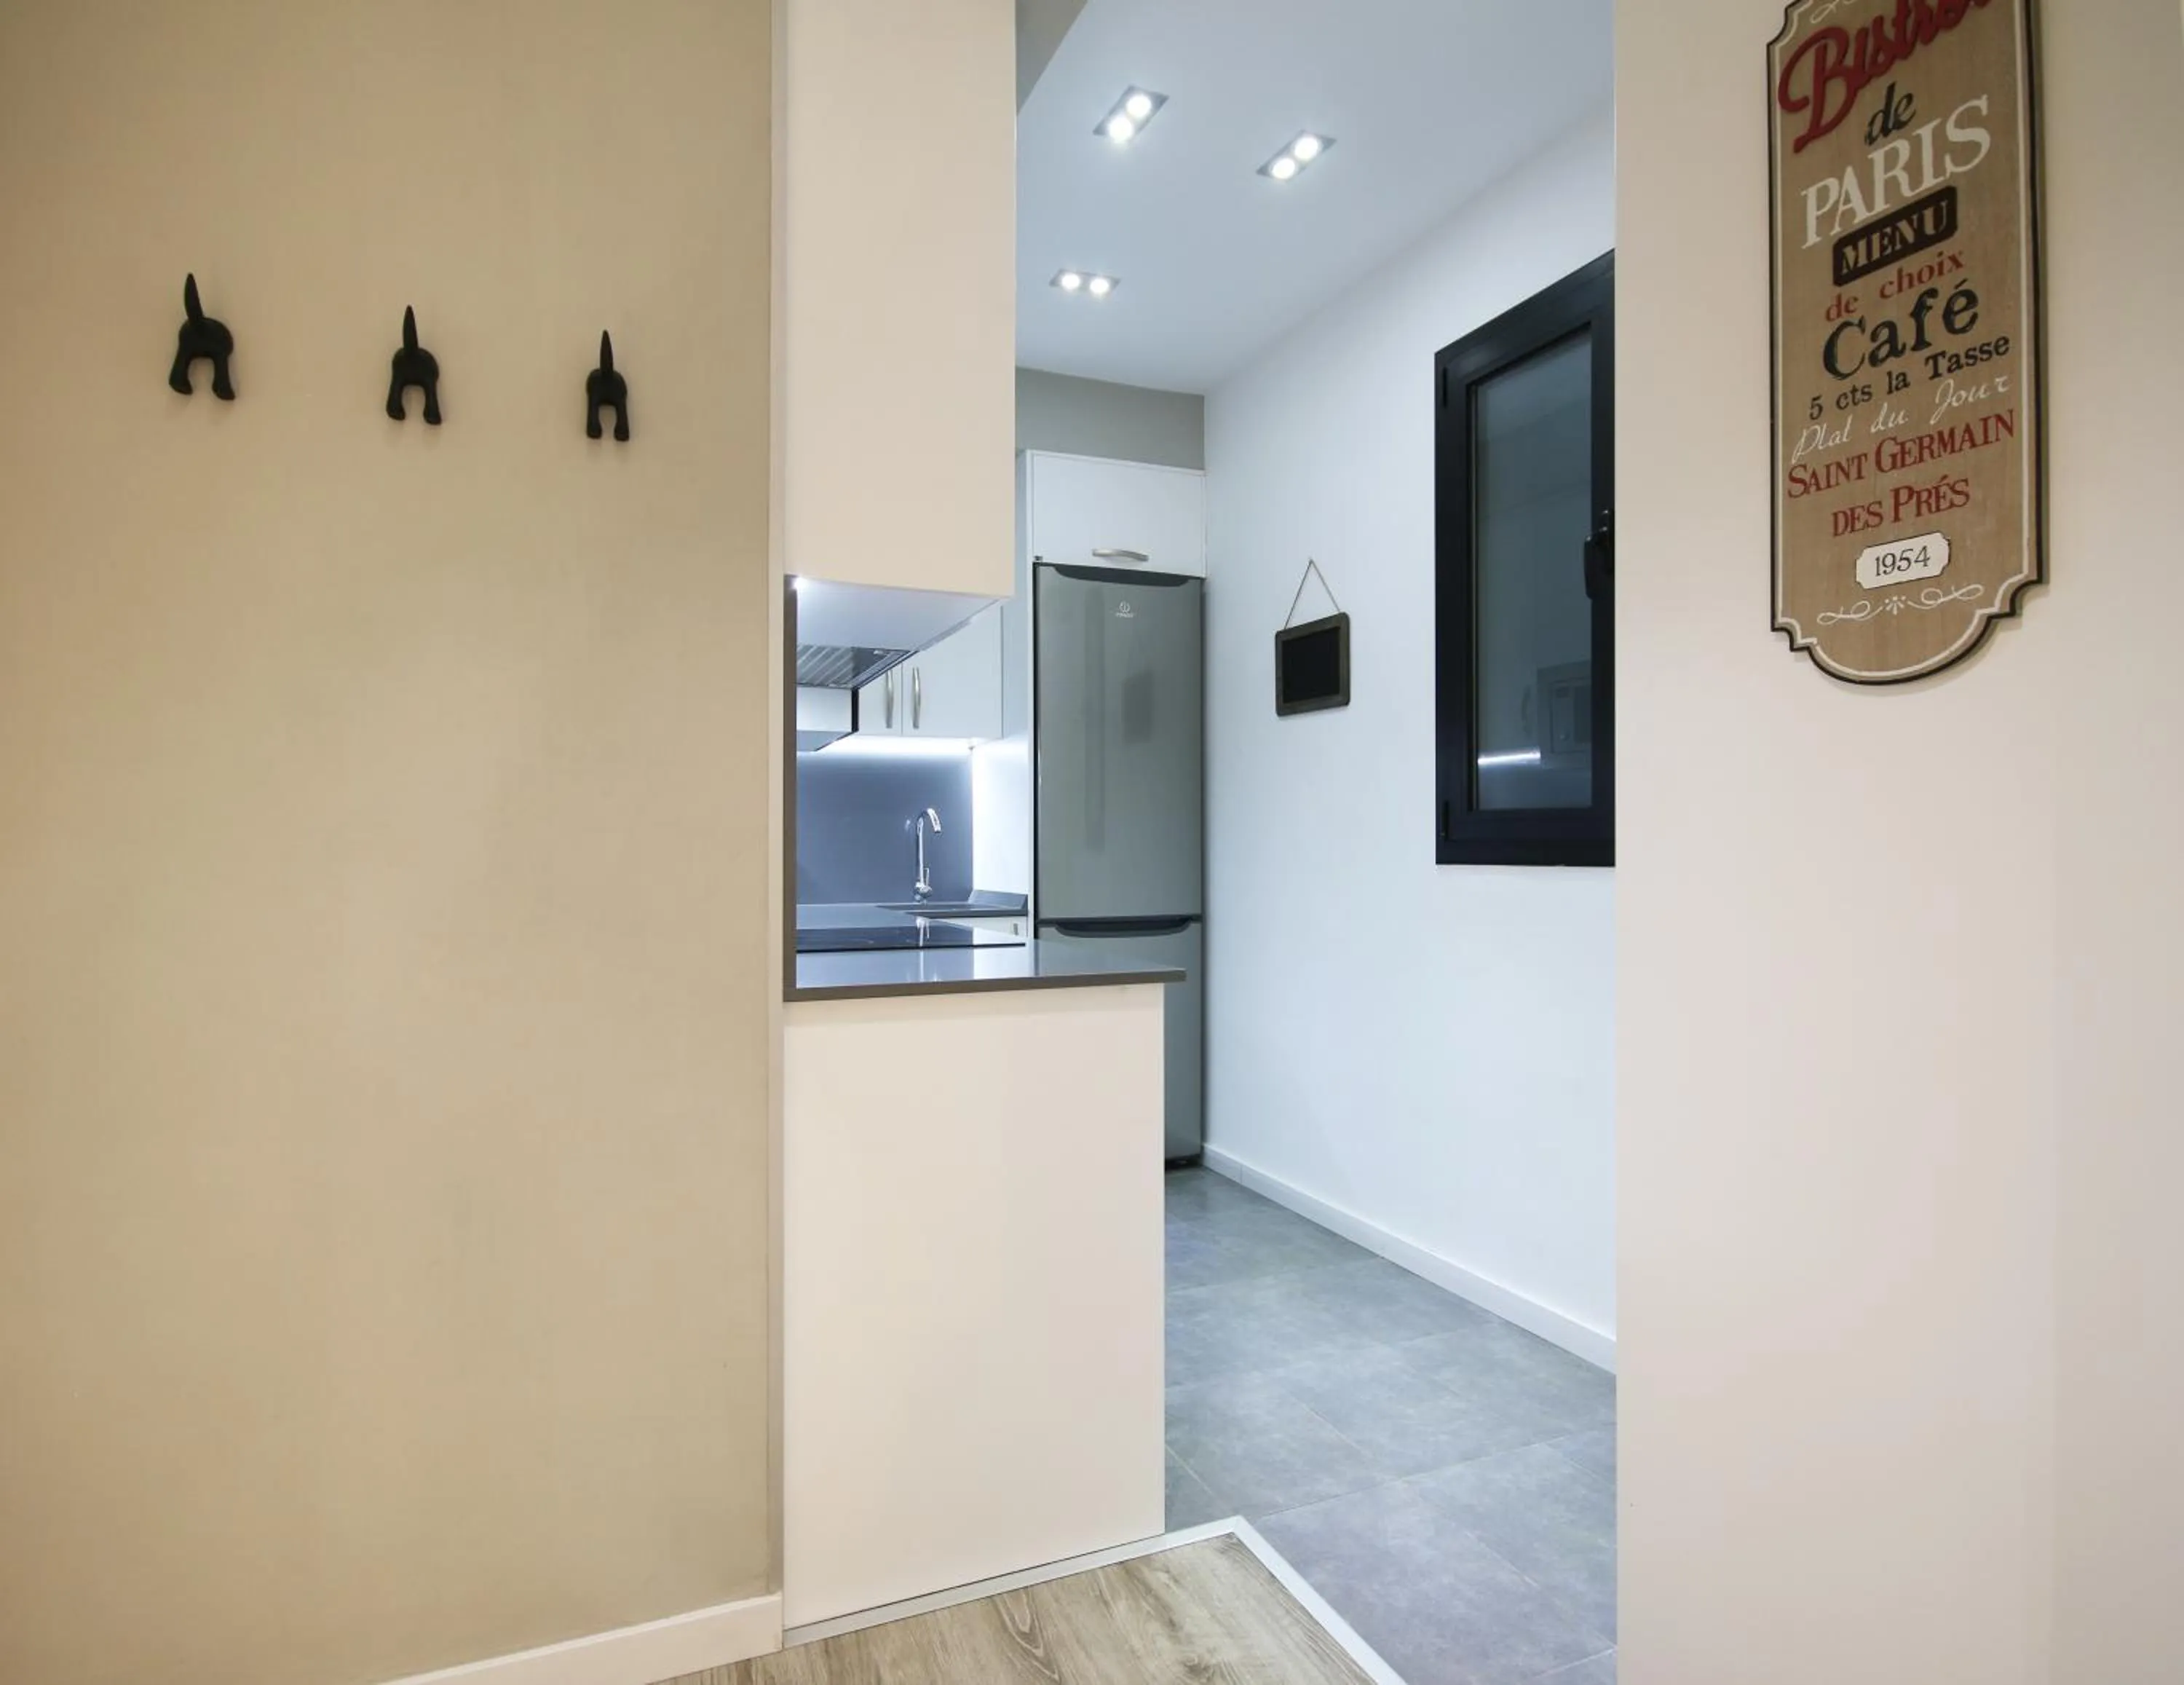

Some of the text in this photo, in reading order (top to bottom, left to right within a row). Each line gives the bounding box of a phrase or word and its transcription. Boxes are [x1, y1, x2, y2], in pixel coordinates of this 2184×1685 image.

[1778, 0, 1992, 154] Bistro
[1864, 81, 1916, 145] de
[1800, 94, 1991, 249] PARIS
[1840, 201, 1948, 275] MENU
[1825, 248, 1965, 321] de choix
[1823, 278, 1979, 380] Café
[1810, 335, 2010, 419] 5 cts la Tasse
[1870, 402, 1908, 434] du
[1929, 377, 2011, 425] Jour
[1788, 409, 2014, 499] SAINT GERMAIN
[1832, 474, 1971, 537] DES PRÉS
[1875, 545, 1931, 577] 1954
